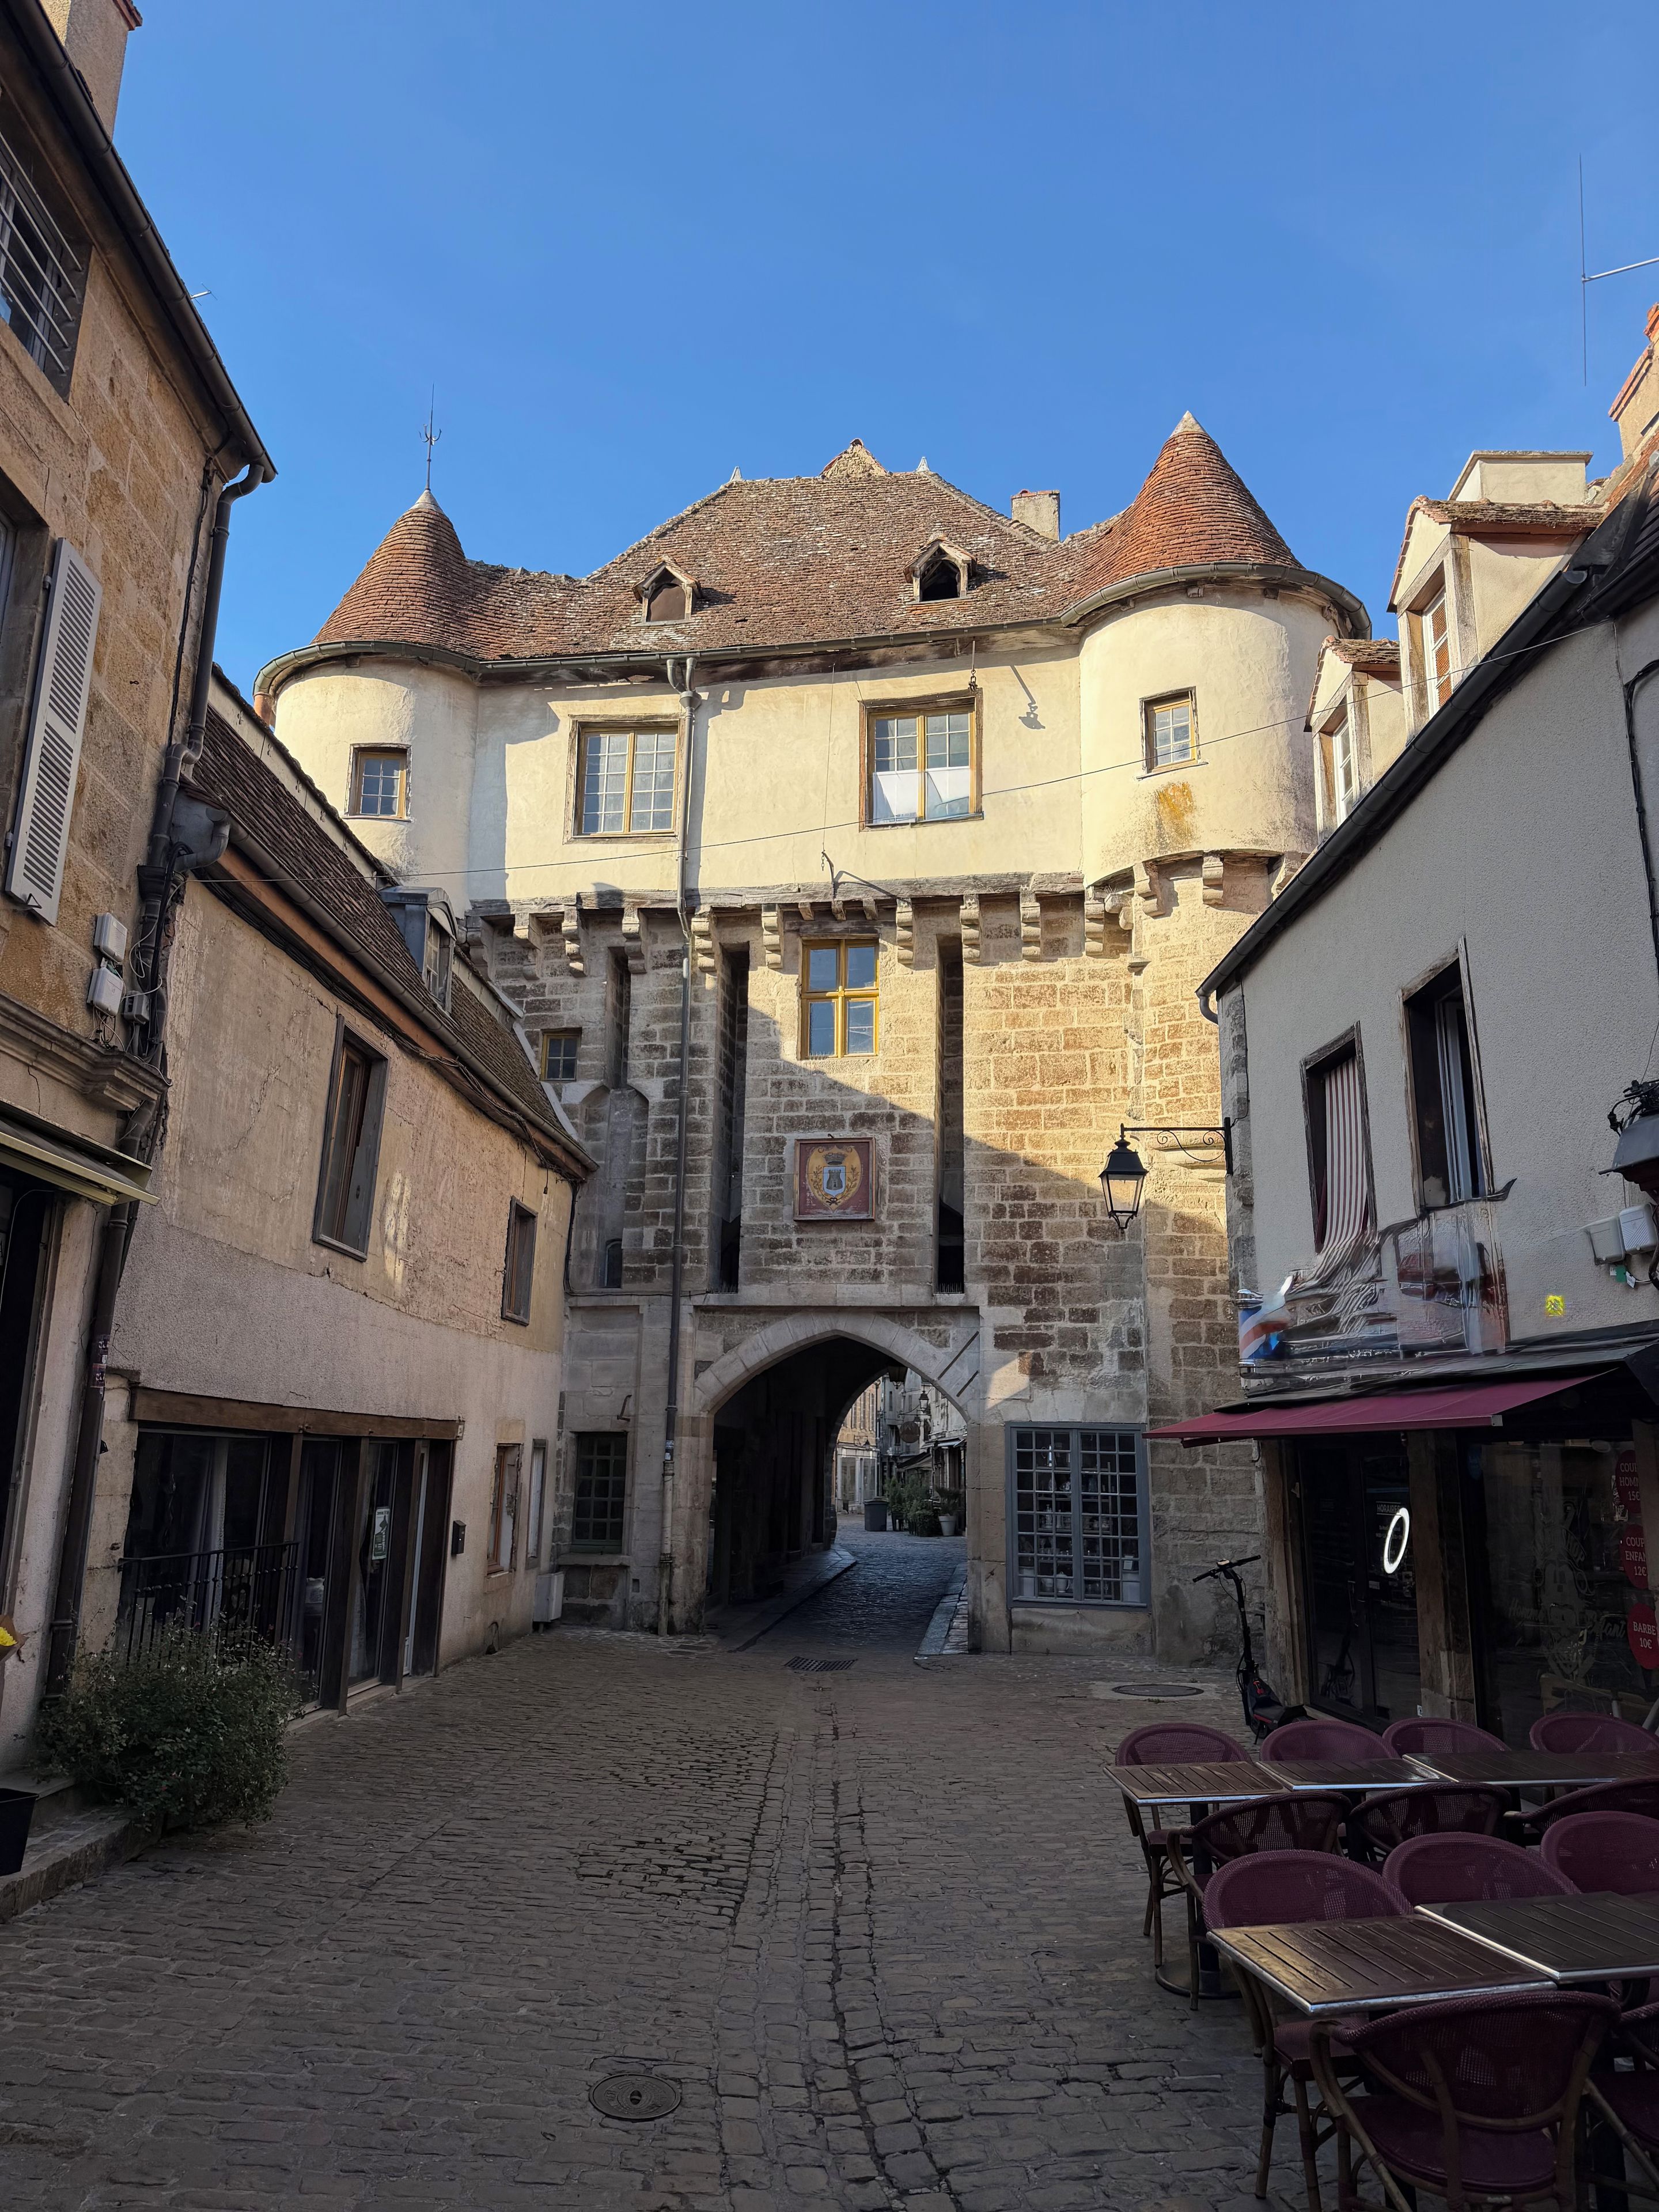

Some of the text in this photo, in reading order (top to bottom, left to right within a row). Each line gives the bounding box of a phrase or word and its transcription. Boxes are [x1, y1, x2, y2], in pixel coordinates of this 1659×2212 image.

[1377, 1504, 1400, 1514] HORAIRES
[1634, 1565, 1647, 1576] 12€
[1633, 1621, 1656, 1635] BARBE
[1639, 1637, 1652, 1649] 10€
